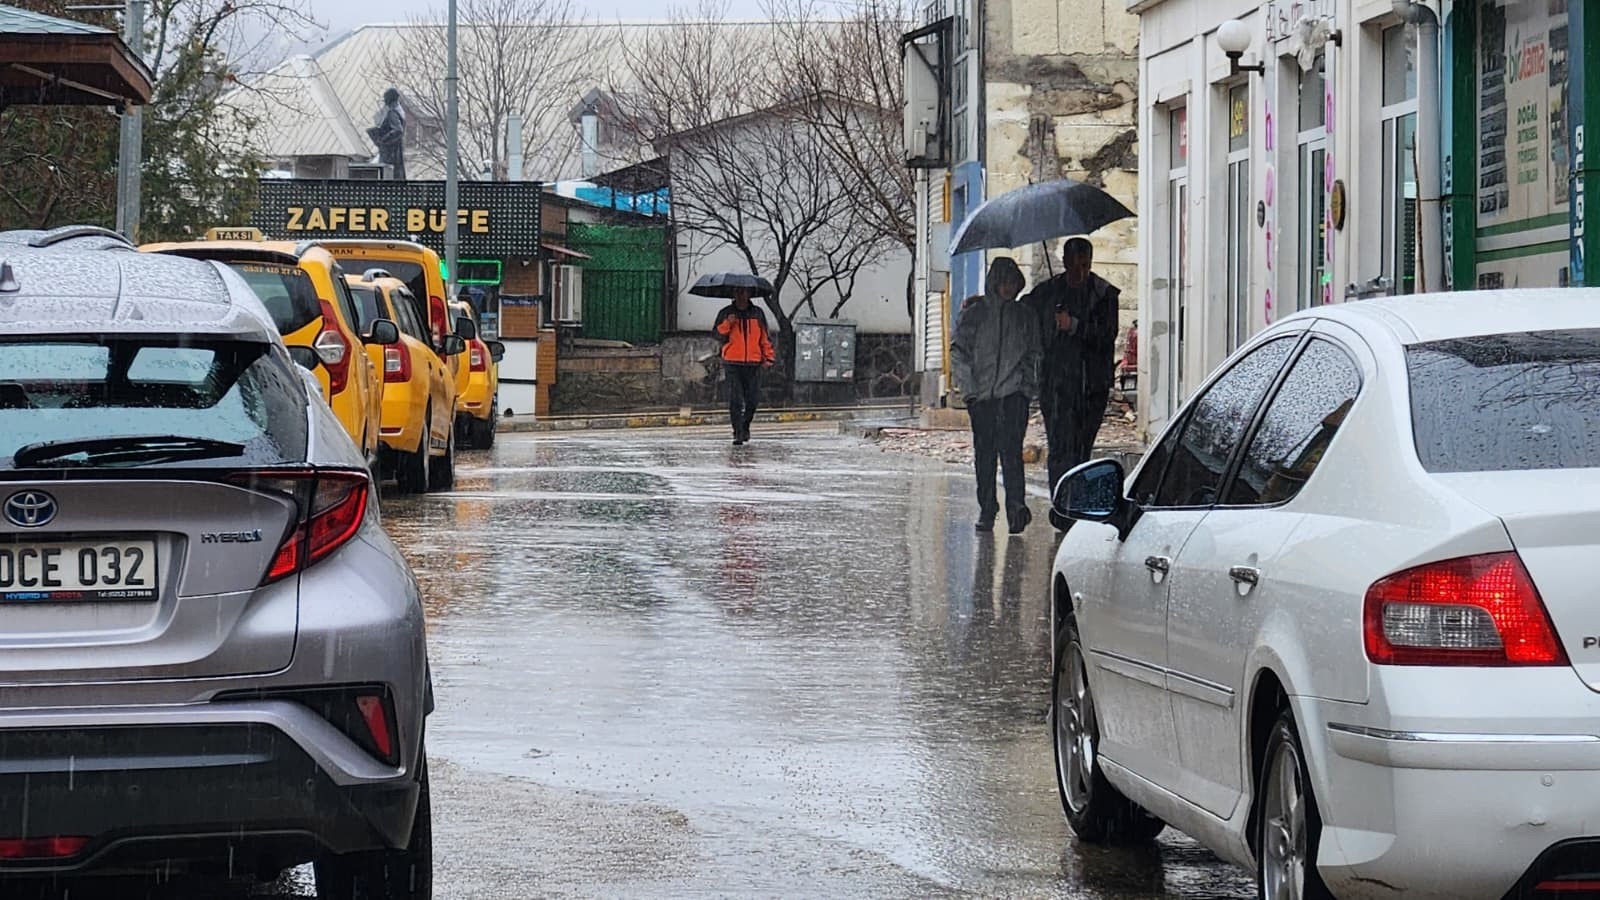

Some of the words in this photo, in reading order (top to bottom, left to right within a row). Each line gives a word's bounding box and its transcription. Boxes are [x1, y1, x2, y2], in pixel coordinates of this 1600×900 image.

[286, 207, 389, 231] ZAFER
[406, 208, 489, 233] BÜFE
[201, 531, 259, 543] HYBRID
[78, 547, 145, 586] 032
